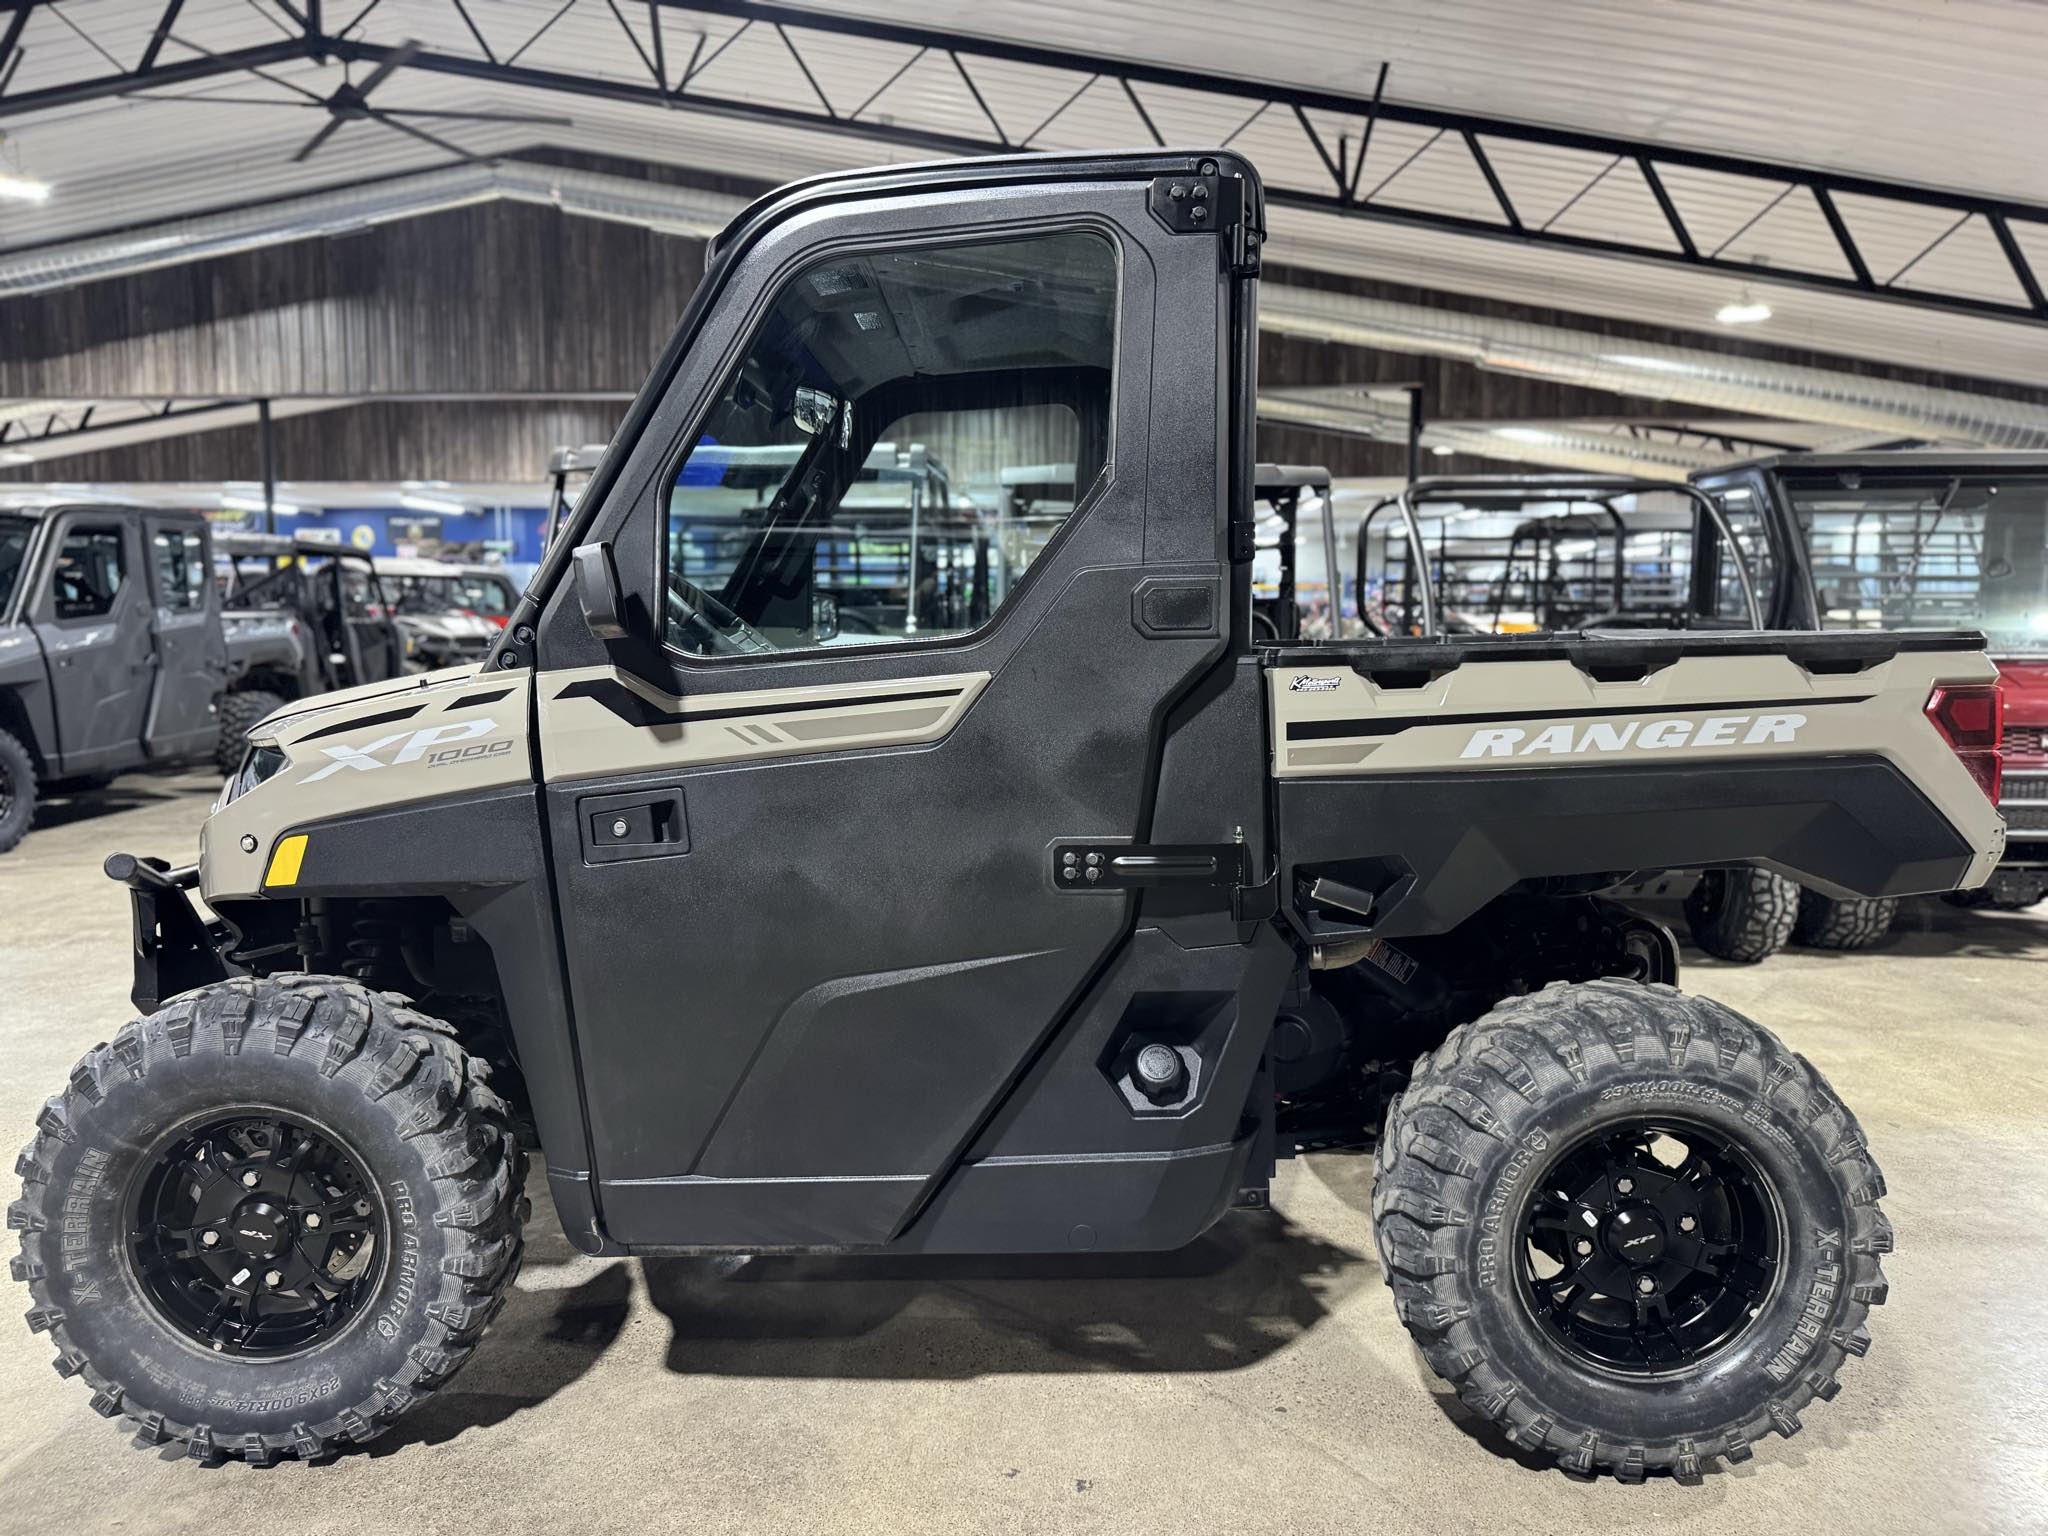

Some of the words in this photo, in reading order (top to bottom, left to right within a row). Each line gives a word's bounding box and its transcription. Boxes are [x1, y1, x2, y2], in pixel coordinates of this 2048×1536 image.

[296, 718, 500, 786] XP
[428, 739, 514, 764] 1000
[1459, 713, 1809, 759] RANGER
[389, 1180, 418, 1228] PRO
[1484, 1147, 1535, 1236] ARMOR
[62, 1146, 112, 1306] X-TERRAIN
[239, 1229, 273, 1241] XP
[1623, 1234, 1657, 1248] XP
[389, 1233, 420, 1321] ARMOR
[1477, 1239, 1498, 1289] PRO
[1765, 1226, 1845, 1384] X-TERRAIN
